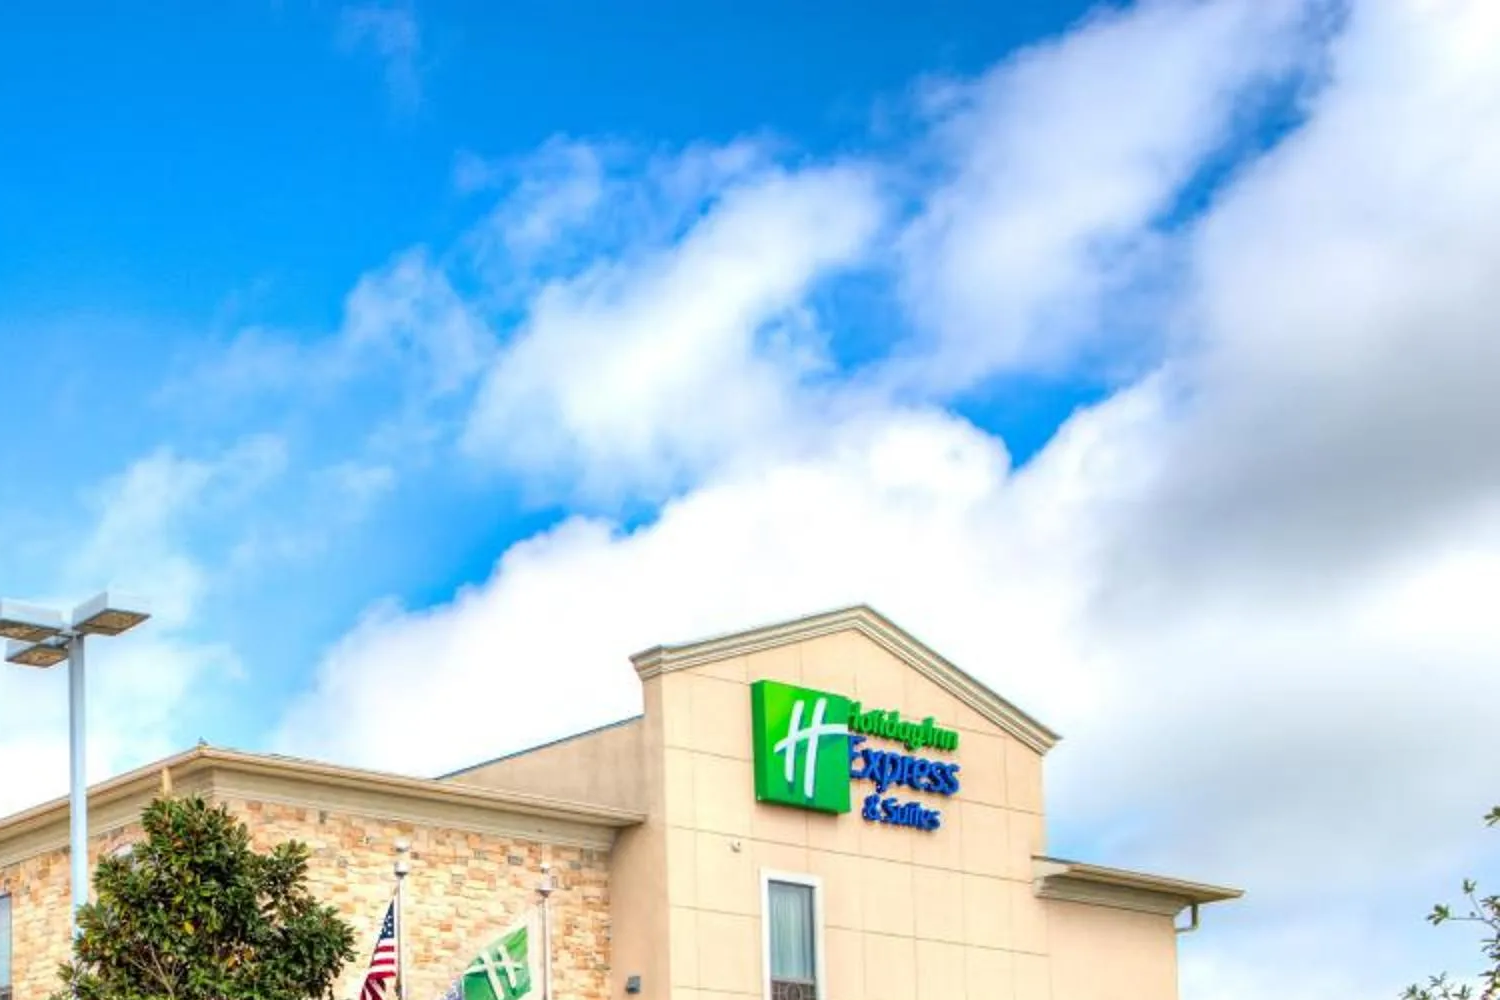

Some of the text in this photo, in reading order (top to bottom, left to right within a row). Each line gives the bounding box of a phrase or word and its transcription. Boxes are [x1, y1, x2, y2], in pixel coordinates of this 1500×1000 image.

[847, 735, 961, 797] Express
[862, 793, 941, 832] & Suites
